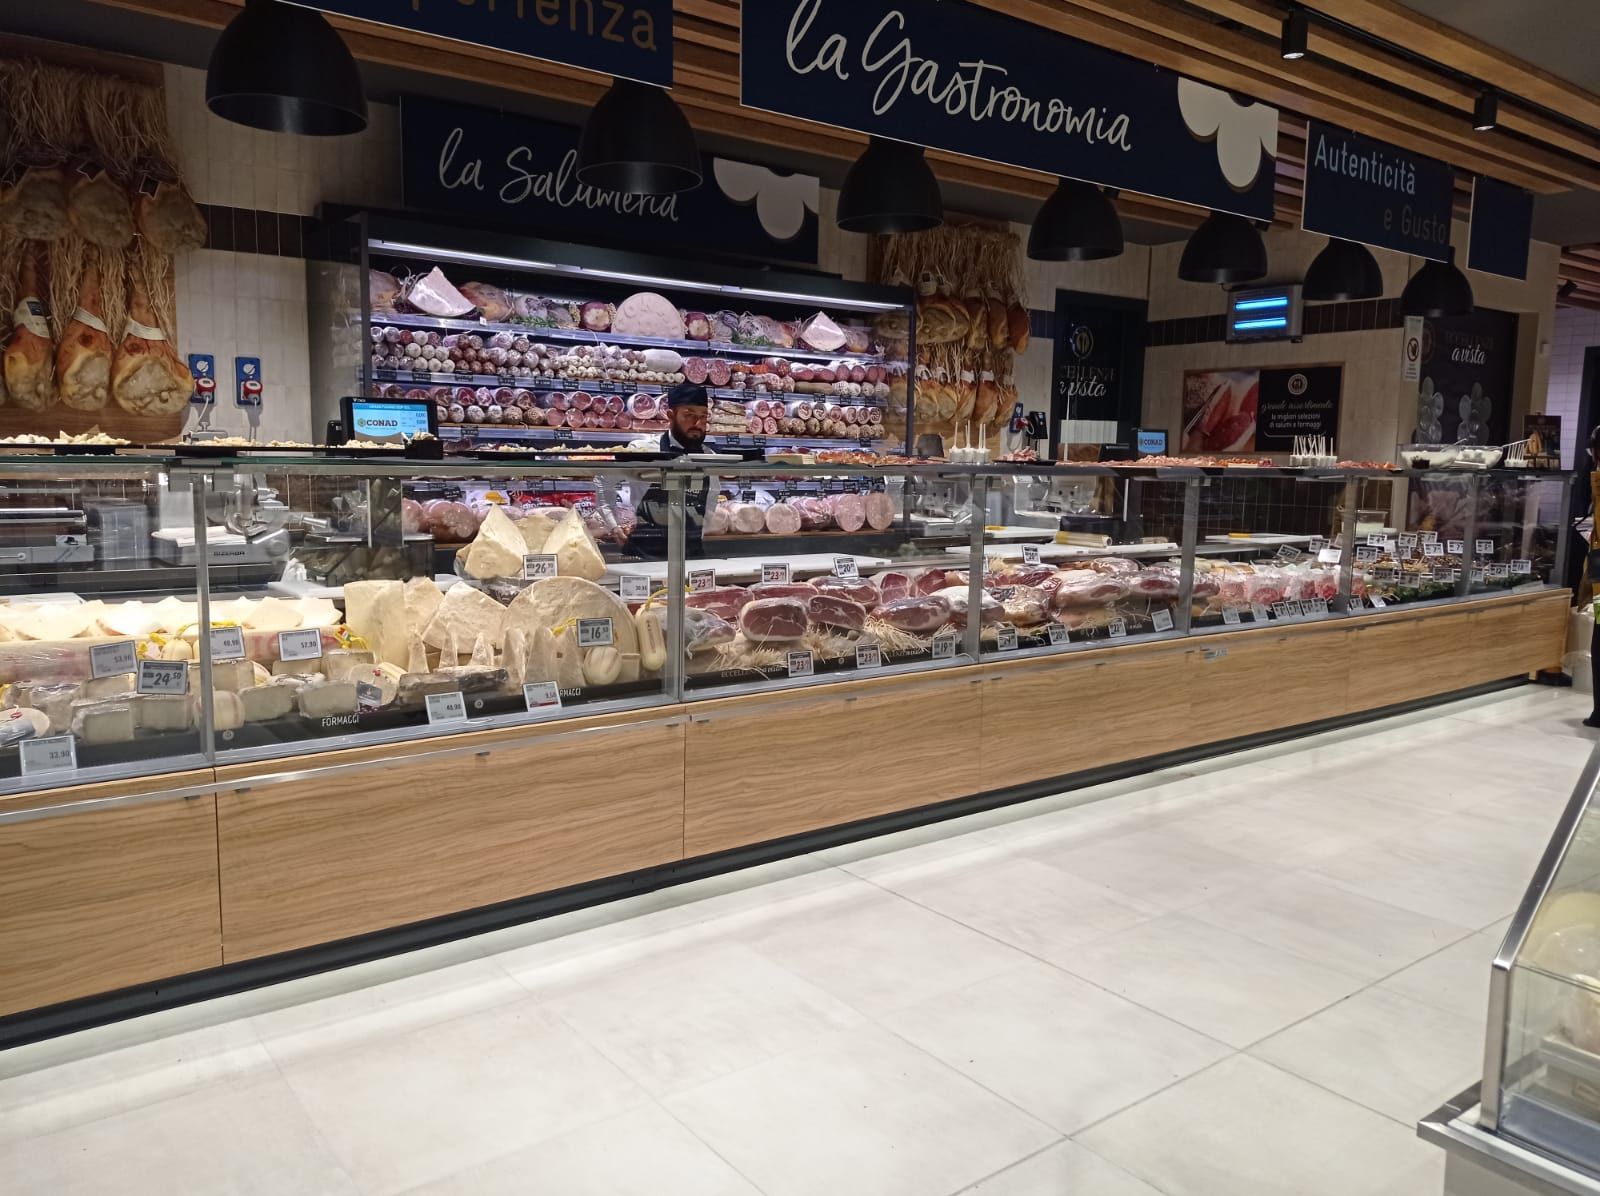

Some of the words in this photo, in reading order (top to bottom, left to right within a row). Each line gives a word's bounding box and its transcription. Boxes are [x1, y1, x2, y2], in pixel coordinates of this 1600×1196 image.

[787, 0, 849, 80] la
[860, 10, 1132, 153] Gastronomia
[438, 127, 484, 191] la
[500, 146, 679, 222] Salumeria
[1314, 133, 1416, 196] Autenticità
[1384, 208, 1393, 230] e
[1402, 205, 1447, 245] Gusto
[366, 419, 398, 427] CONAD
[321, 714, 360, 727] FORMAGGI
